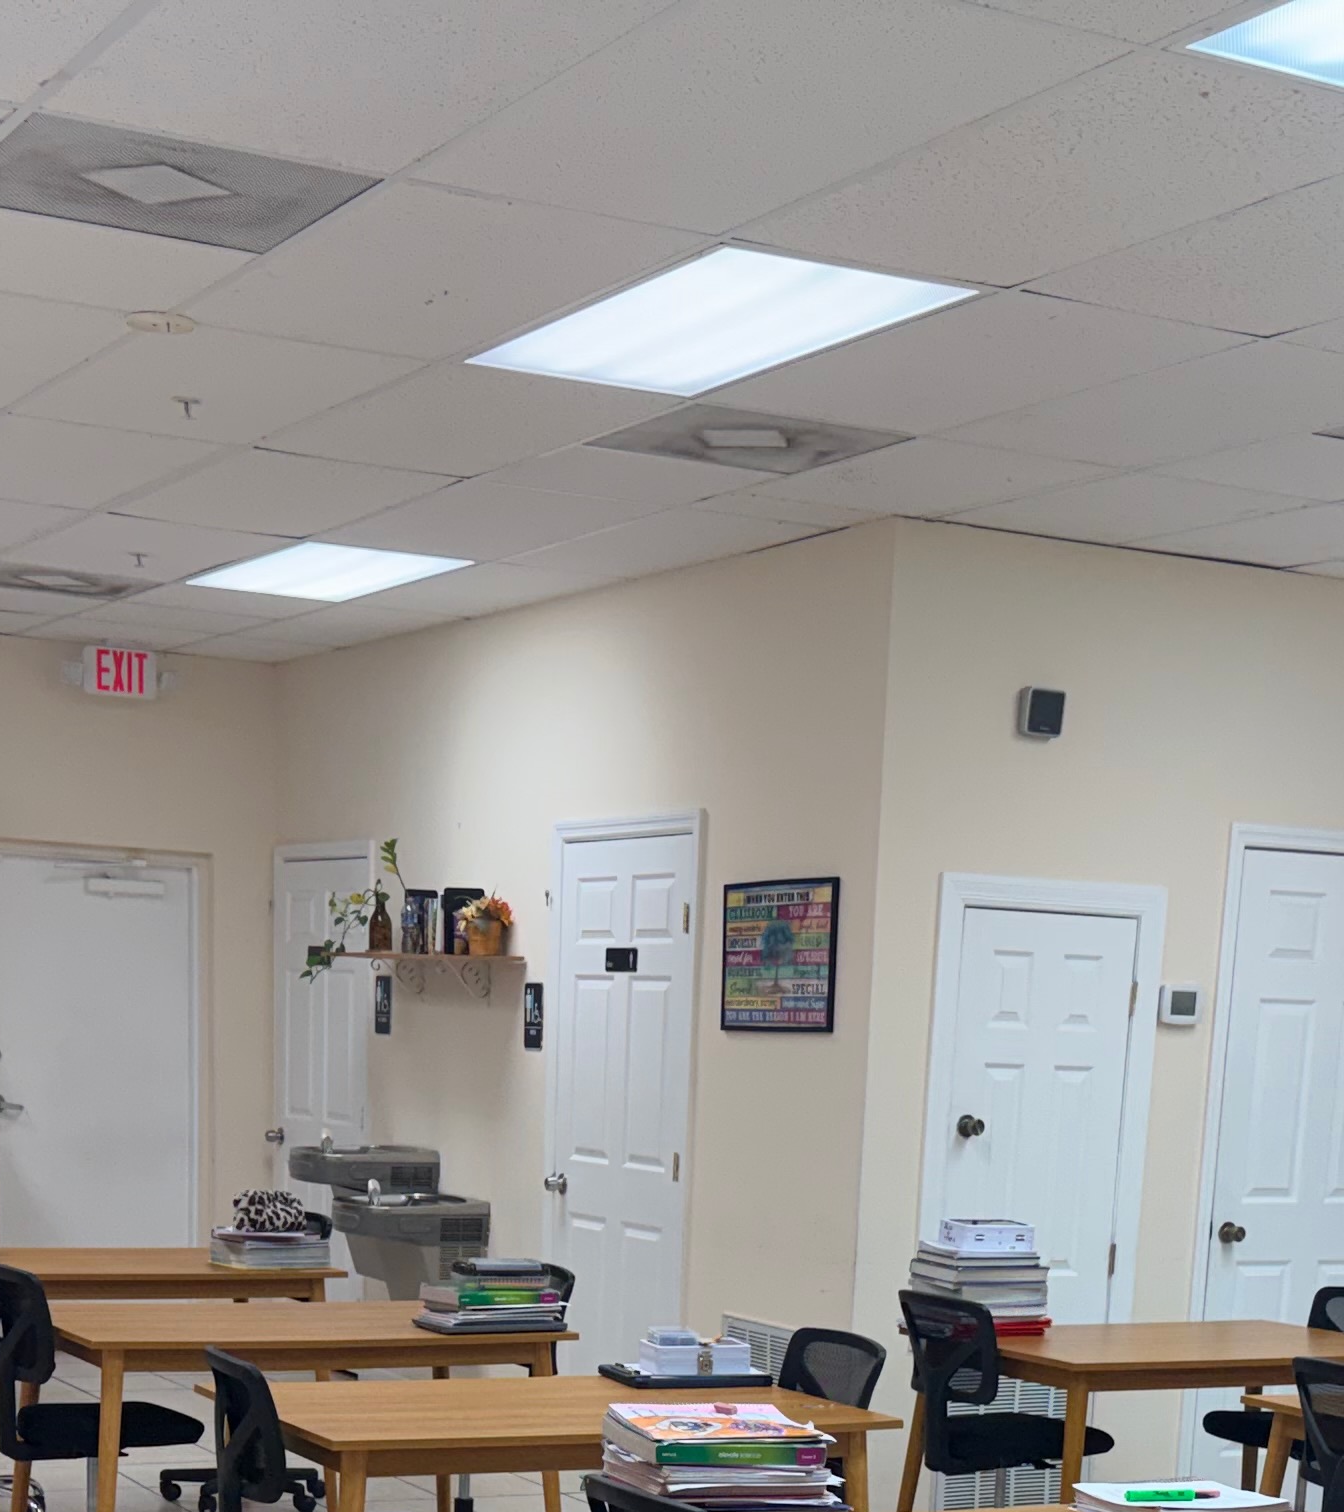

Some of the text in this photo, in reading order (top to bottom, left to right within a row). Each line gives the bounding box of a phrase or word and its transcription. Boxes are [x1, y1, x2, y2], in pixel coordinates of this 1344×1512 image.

[96, 648, 148, 695] EXIT
[788, 904, 805, 918] YOU
[791, 983, 826, 995] SPECIAL
